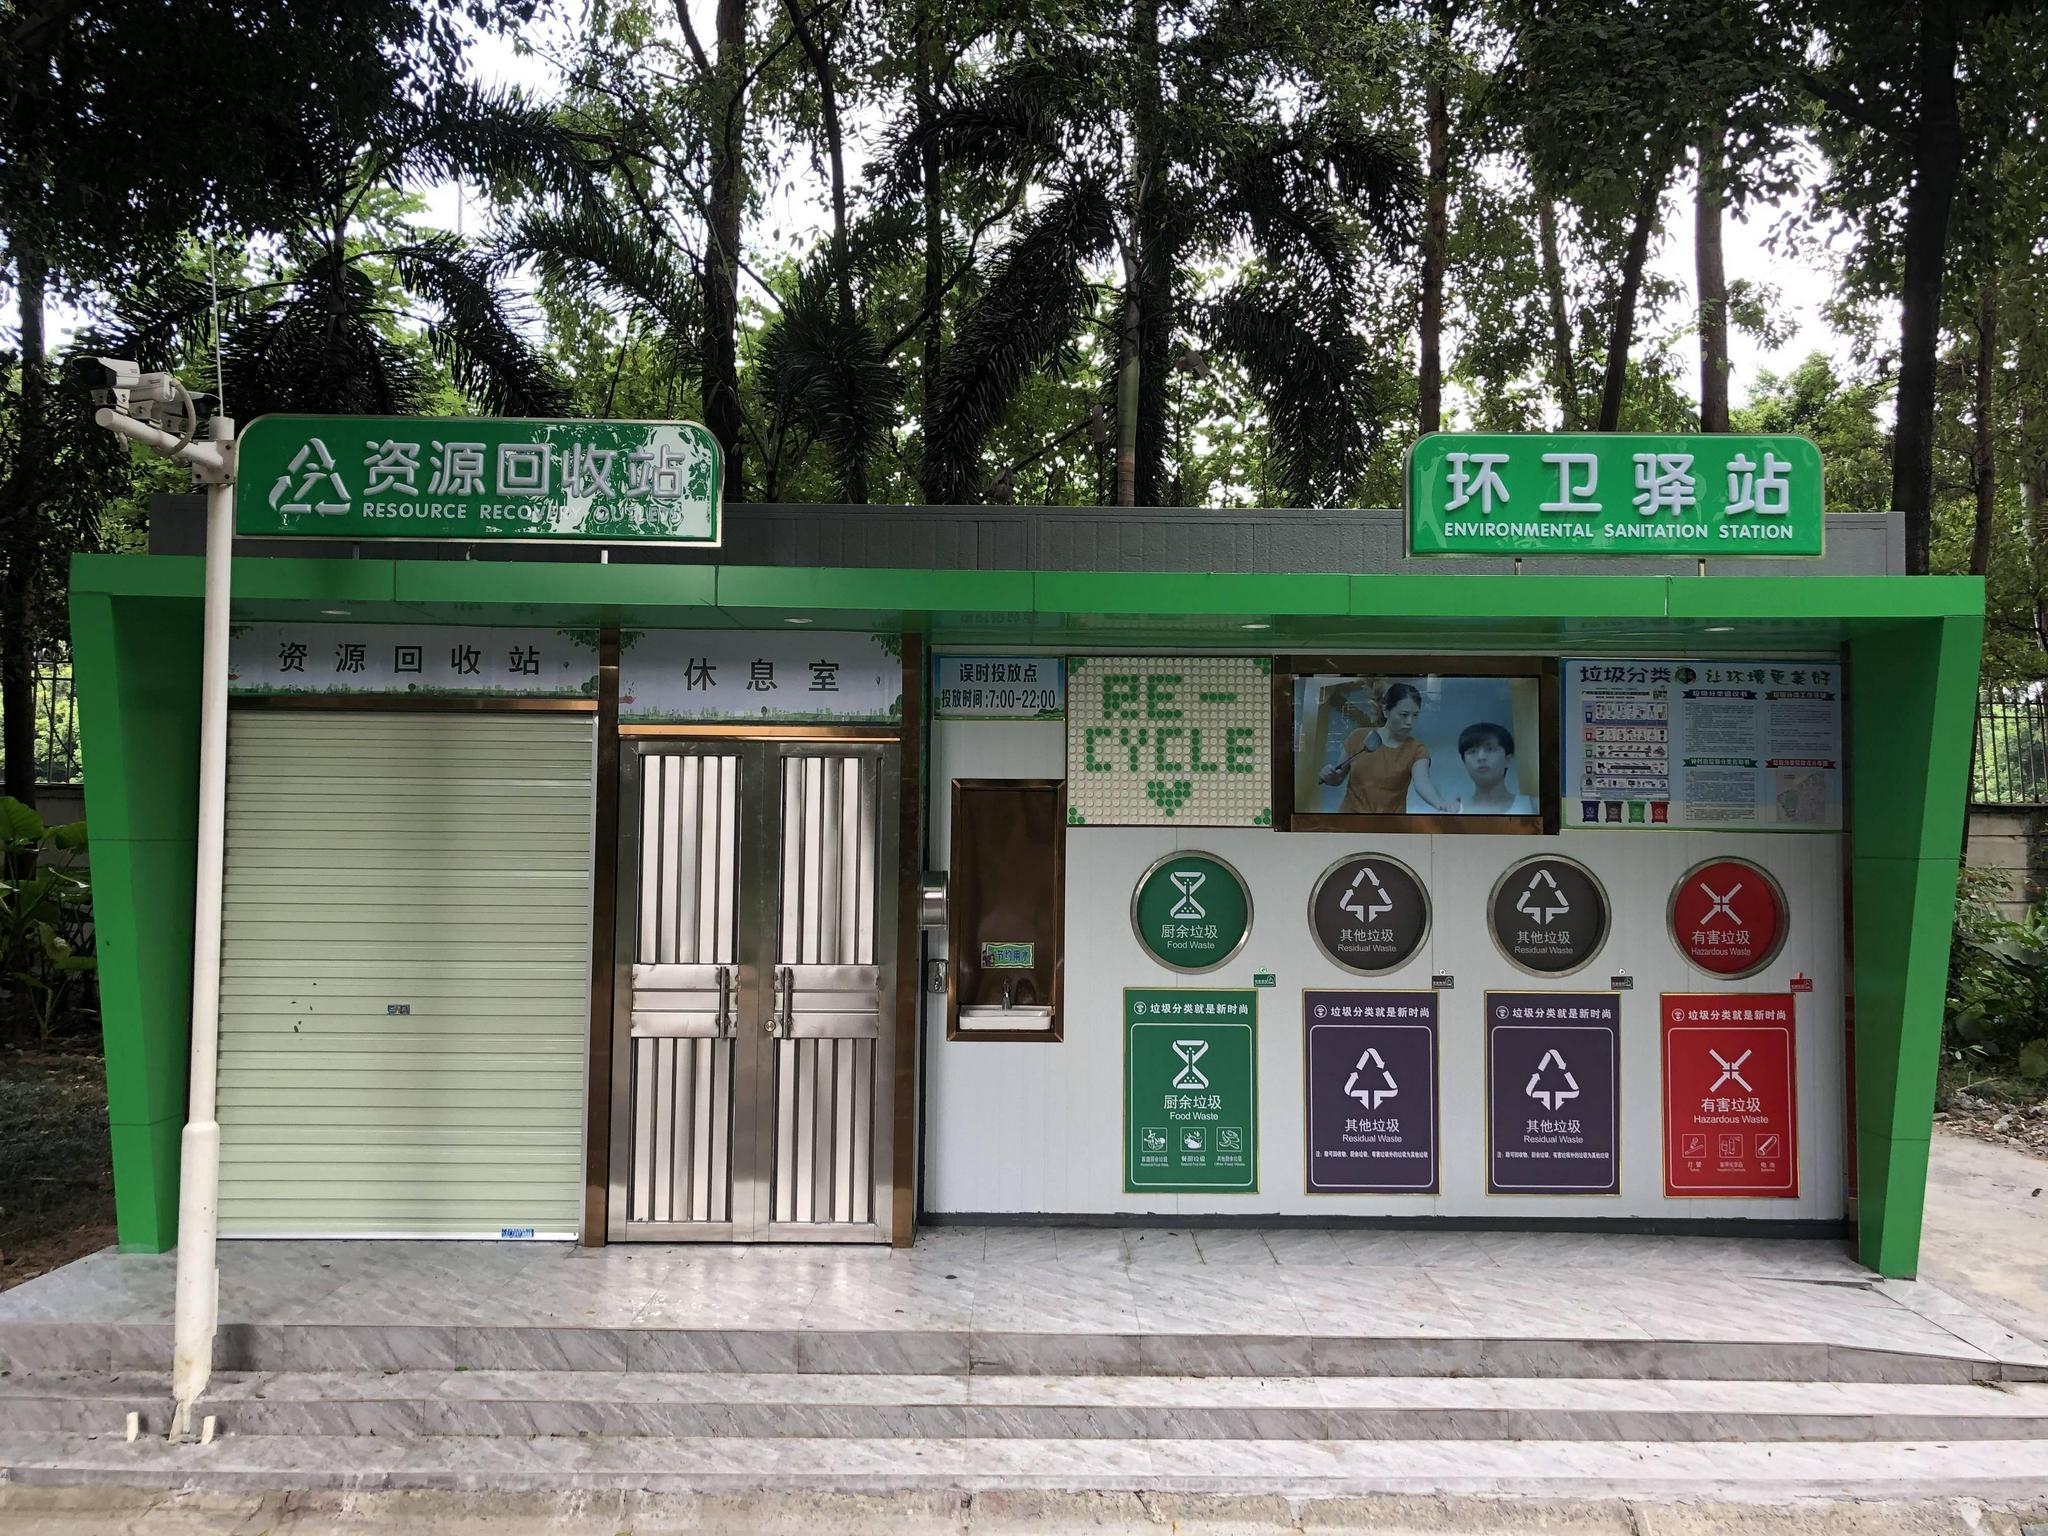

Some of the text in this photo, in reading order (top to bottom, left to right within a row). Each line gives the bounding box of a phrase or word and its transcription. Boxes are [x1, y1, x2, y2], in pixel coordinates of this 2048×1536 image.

[363, 438, 685, 500] 资源回收站
[1444, 451, 1793, 516] 环卫驿站
[362, 502, 468, 519] RESOURCE
[479, 504, 580, 520] RECOVERY
[1444, 522, 1793, 539] ENVIRONMENTAL SANITATION STATION
[278, 642, 541, 676] 资源回收站
[683, 657, 841, 692] 休息室
[959, 662, 1038, 683] 误时投放点
[1579, 665, 1672, 684] 垃圾分类
[1085, 727, 1253, 773] CYCLE
[1161, 924, 1219, 939] 厨余垃圾
[1339, 928, 1394, 943] 其他垃圾
[1515, 930, 1571, 945] 其他垃圾
[1691, 930, 1751, 946] 有害垃圾
[1166, 940, 1216, 951] Food Waste
[1337, 943, 1397, 953] Residual Waste
[1514, 945, 1574, 955] Residual Waste
[1690, 947, 1752, 957] Hazardous Waste
[1150, 1002, 1249, 1015] 垃圾分类就是新时尚
[1330, 1006, 1430, 1018] 垃圾分类就是新时尚
[1512, 1007, 1612, 1019] 垃圾分类就是新时尚
[1687, 1009, 1787, 1021] 垃圾分类就是新时尚
[1163, 1094, 1222, 1110] 厨余垃圾
[1700, 1097, 1761, 1113] 有害垃圾
[1169, 1111, 1219, 1121] Food Waste
[1693, 1114, 1769, 1125] Hazardous Waste
[1344, 1118, 1400, 1133] 其他垃圾
[1525, 1119, 1581, 1134] 其他垃圾
[1342, 1133, 1403, 1143] Residual Waste
[1523, 1134, 1584, 1144] Residual Waste
